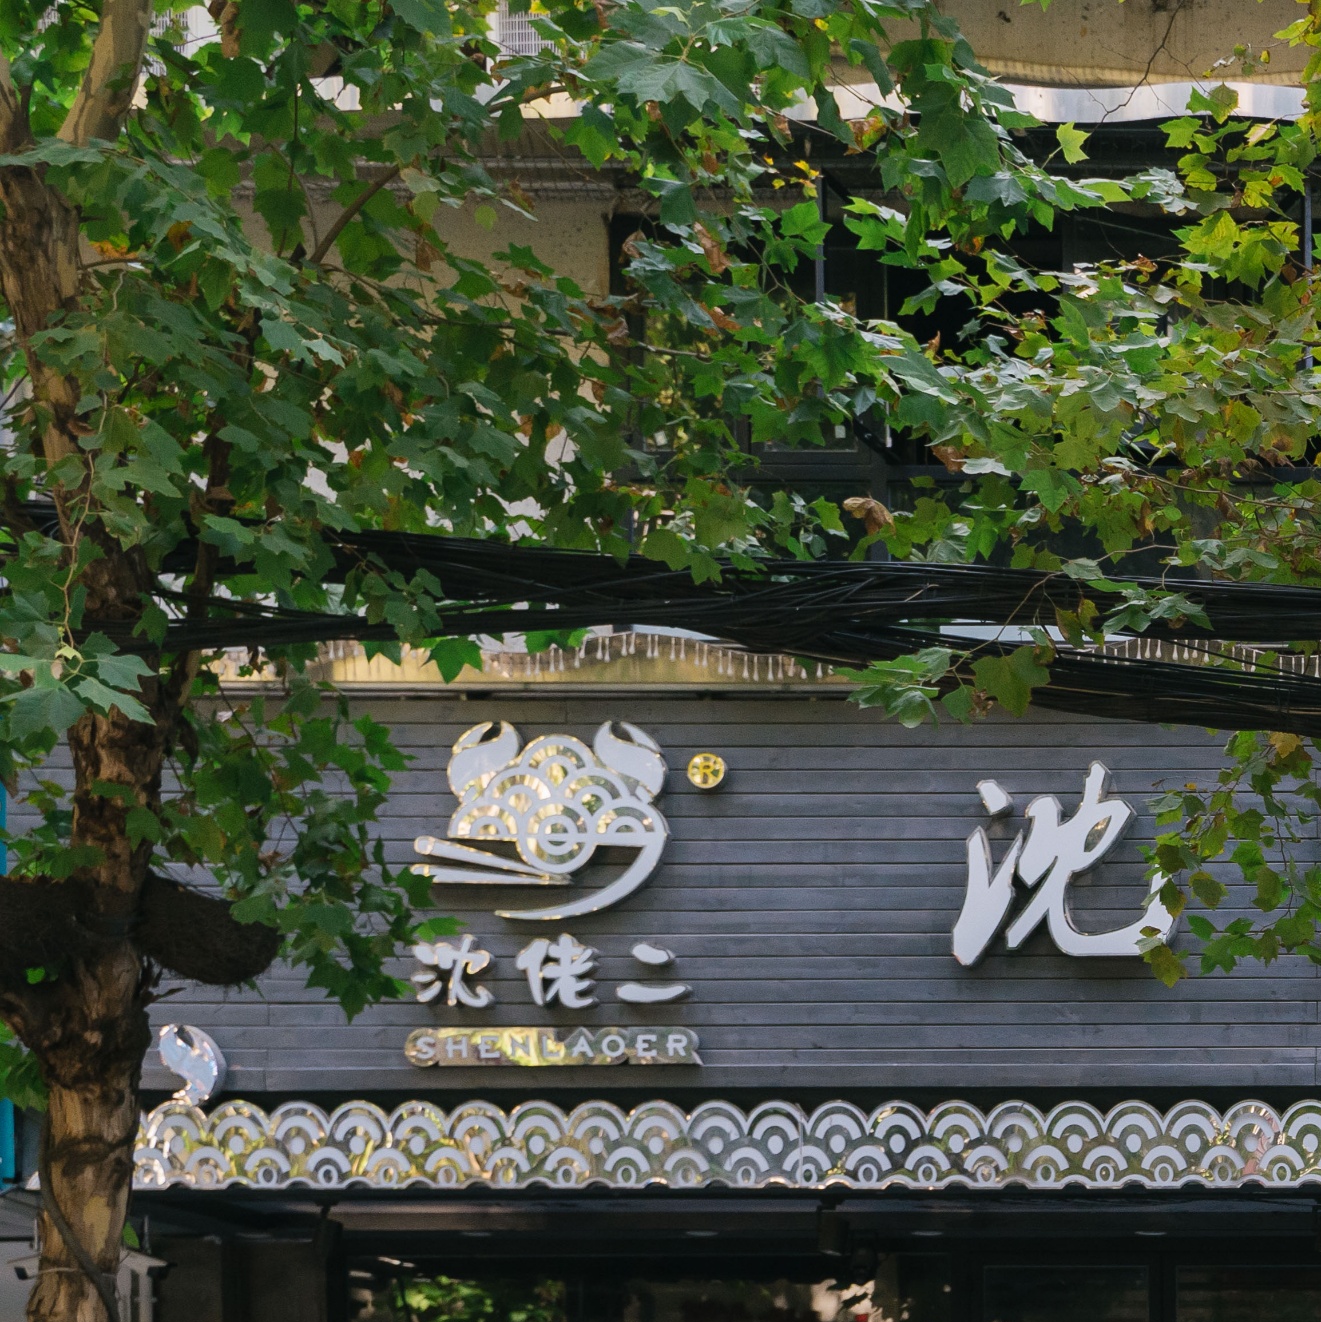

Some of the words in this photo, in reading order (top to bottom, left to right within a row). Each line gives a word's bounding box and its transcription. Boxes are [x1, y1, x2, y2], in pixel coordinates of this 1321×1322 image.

[411, 933, 692, 1009] 沈佬二
[413, 1034, 690, 1060] SHENLAOER
